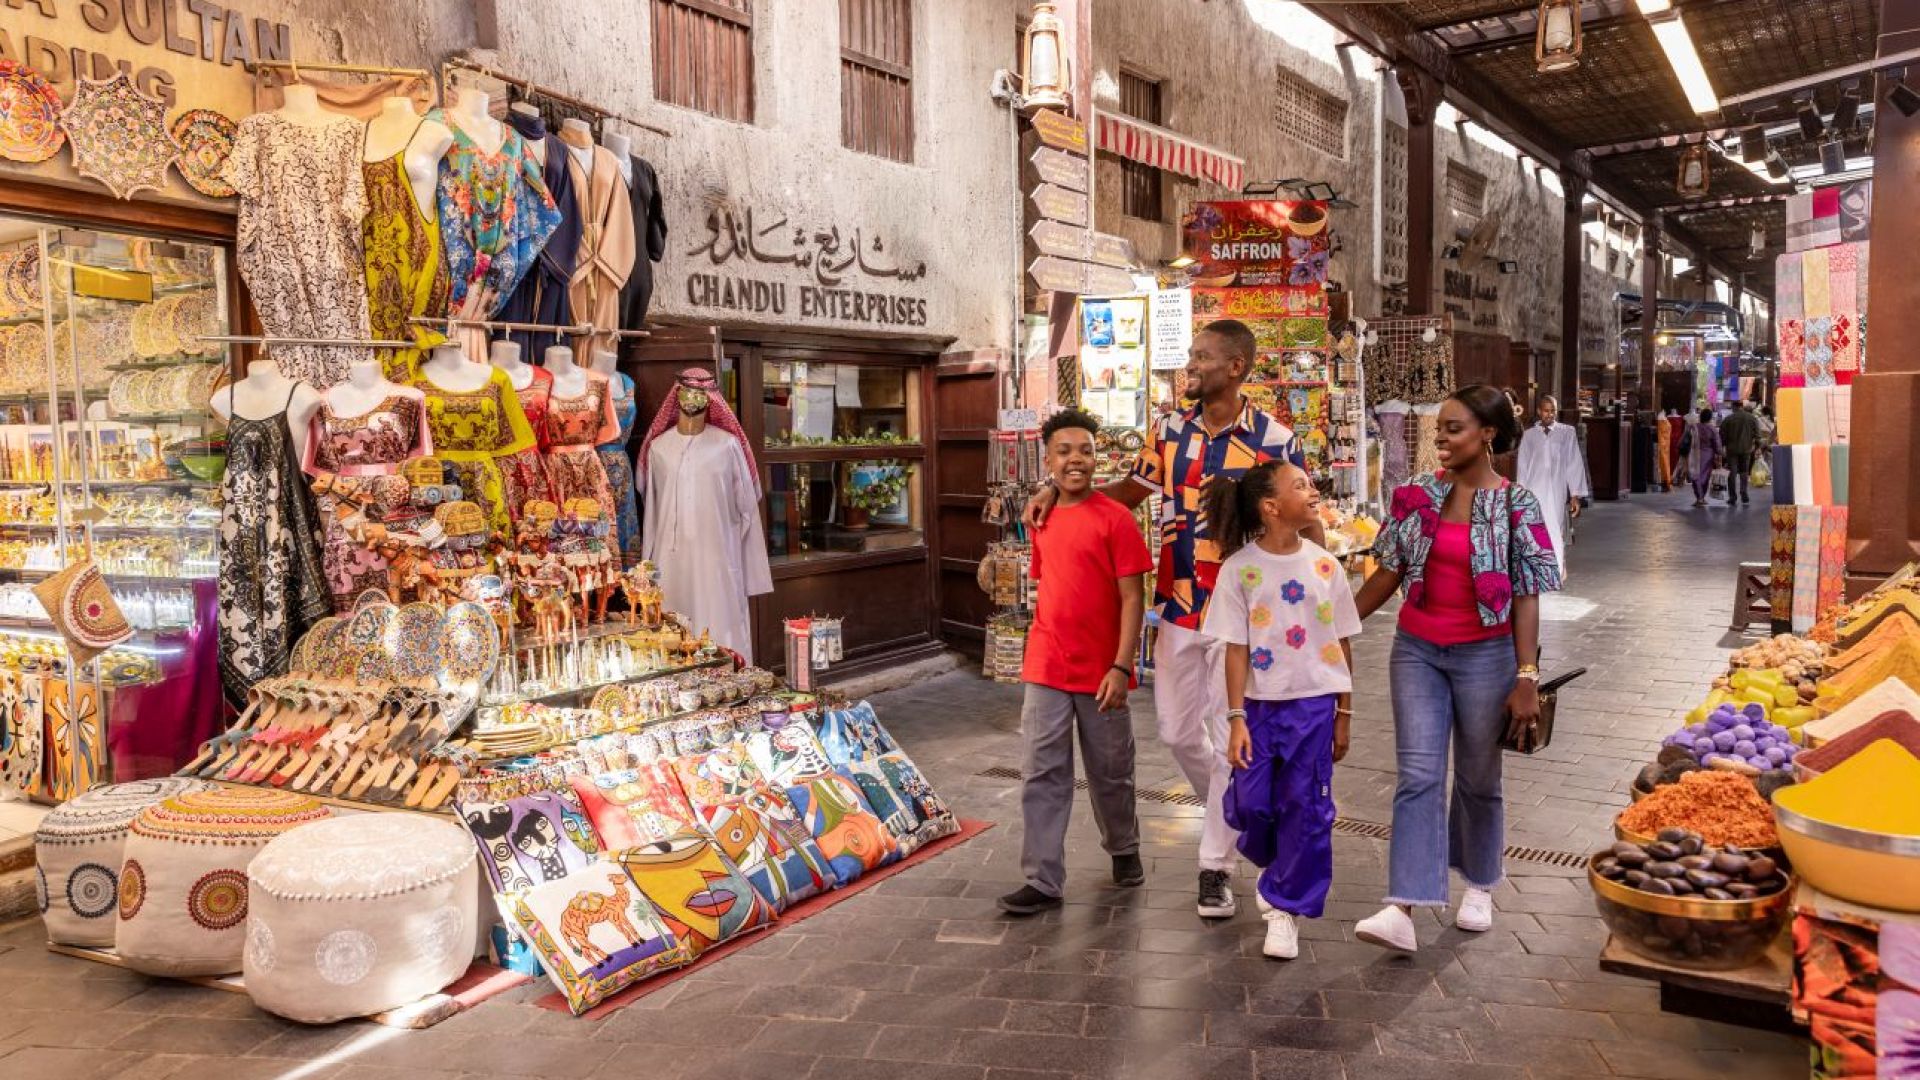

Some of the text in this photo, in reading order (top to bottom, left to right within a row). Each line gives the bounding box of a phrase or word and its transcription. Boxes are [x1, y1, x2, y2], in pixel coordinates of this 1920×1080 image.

[82, 0, 291, 73] SULTAN
[815, 224, 926, 286] مشاريع
[1211, 241, 1282, 260] SAFFRON
[687, 273, 927, 326] CHANDU ENTERPRISES
